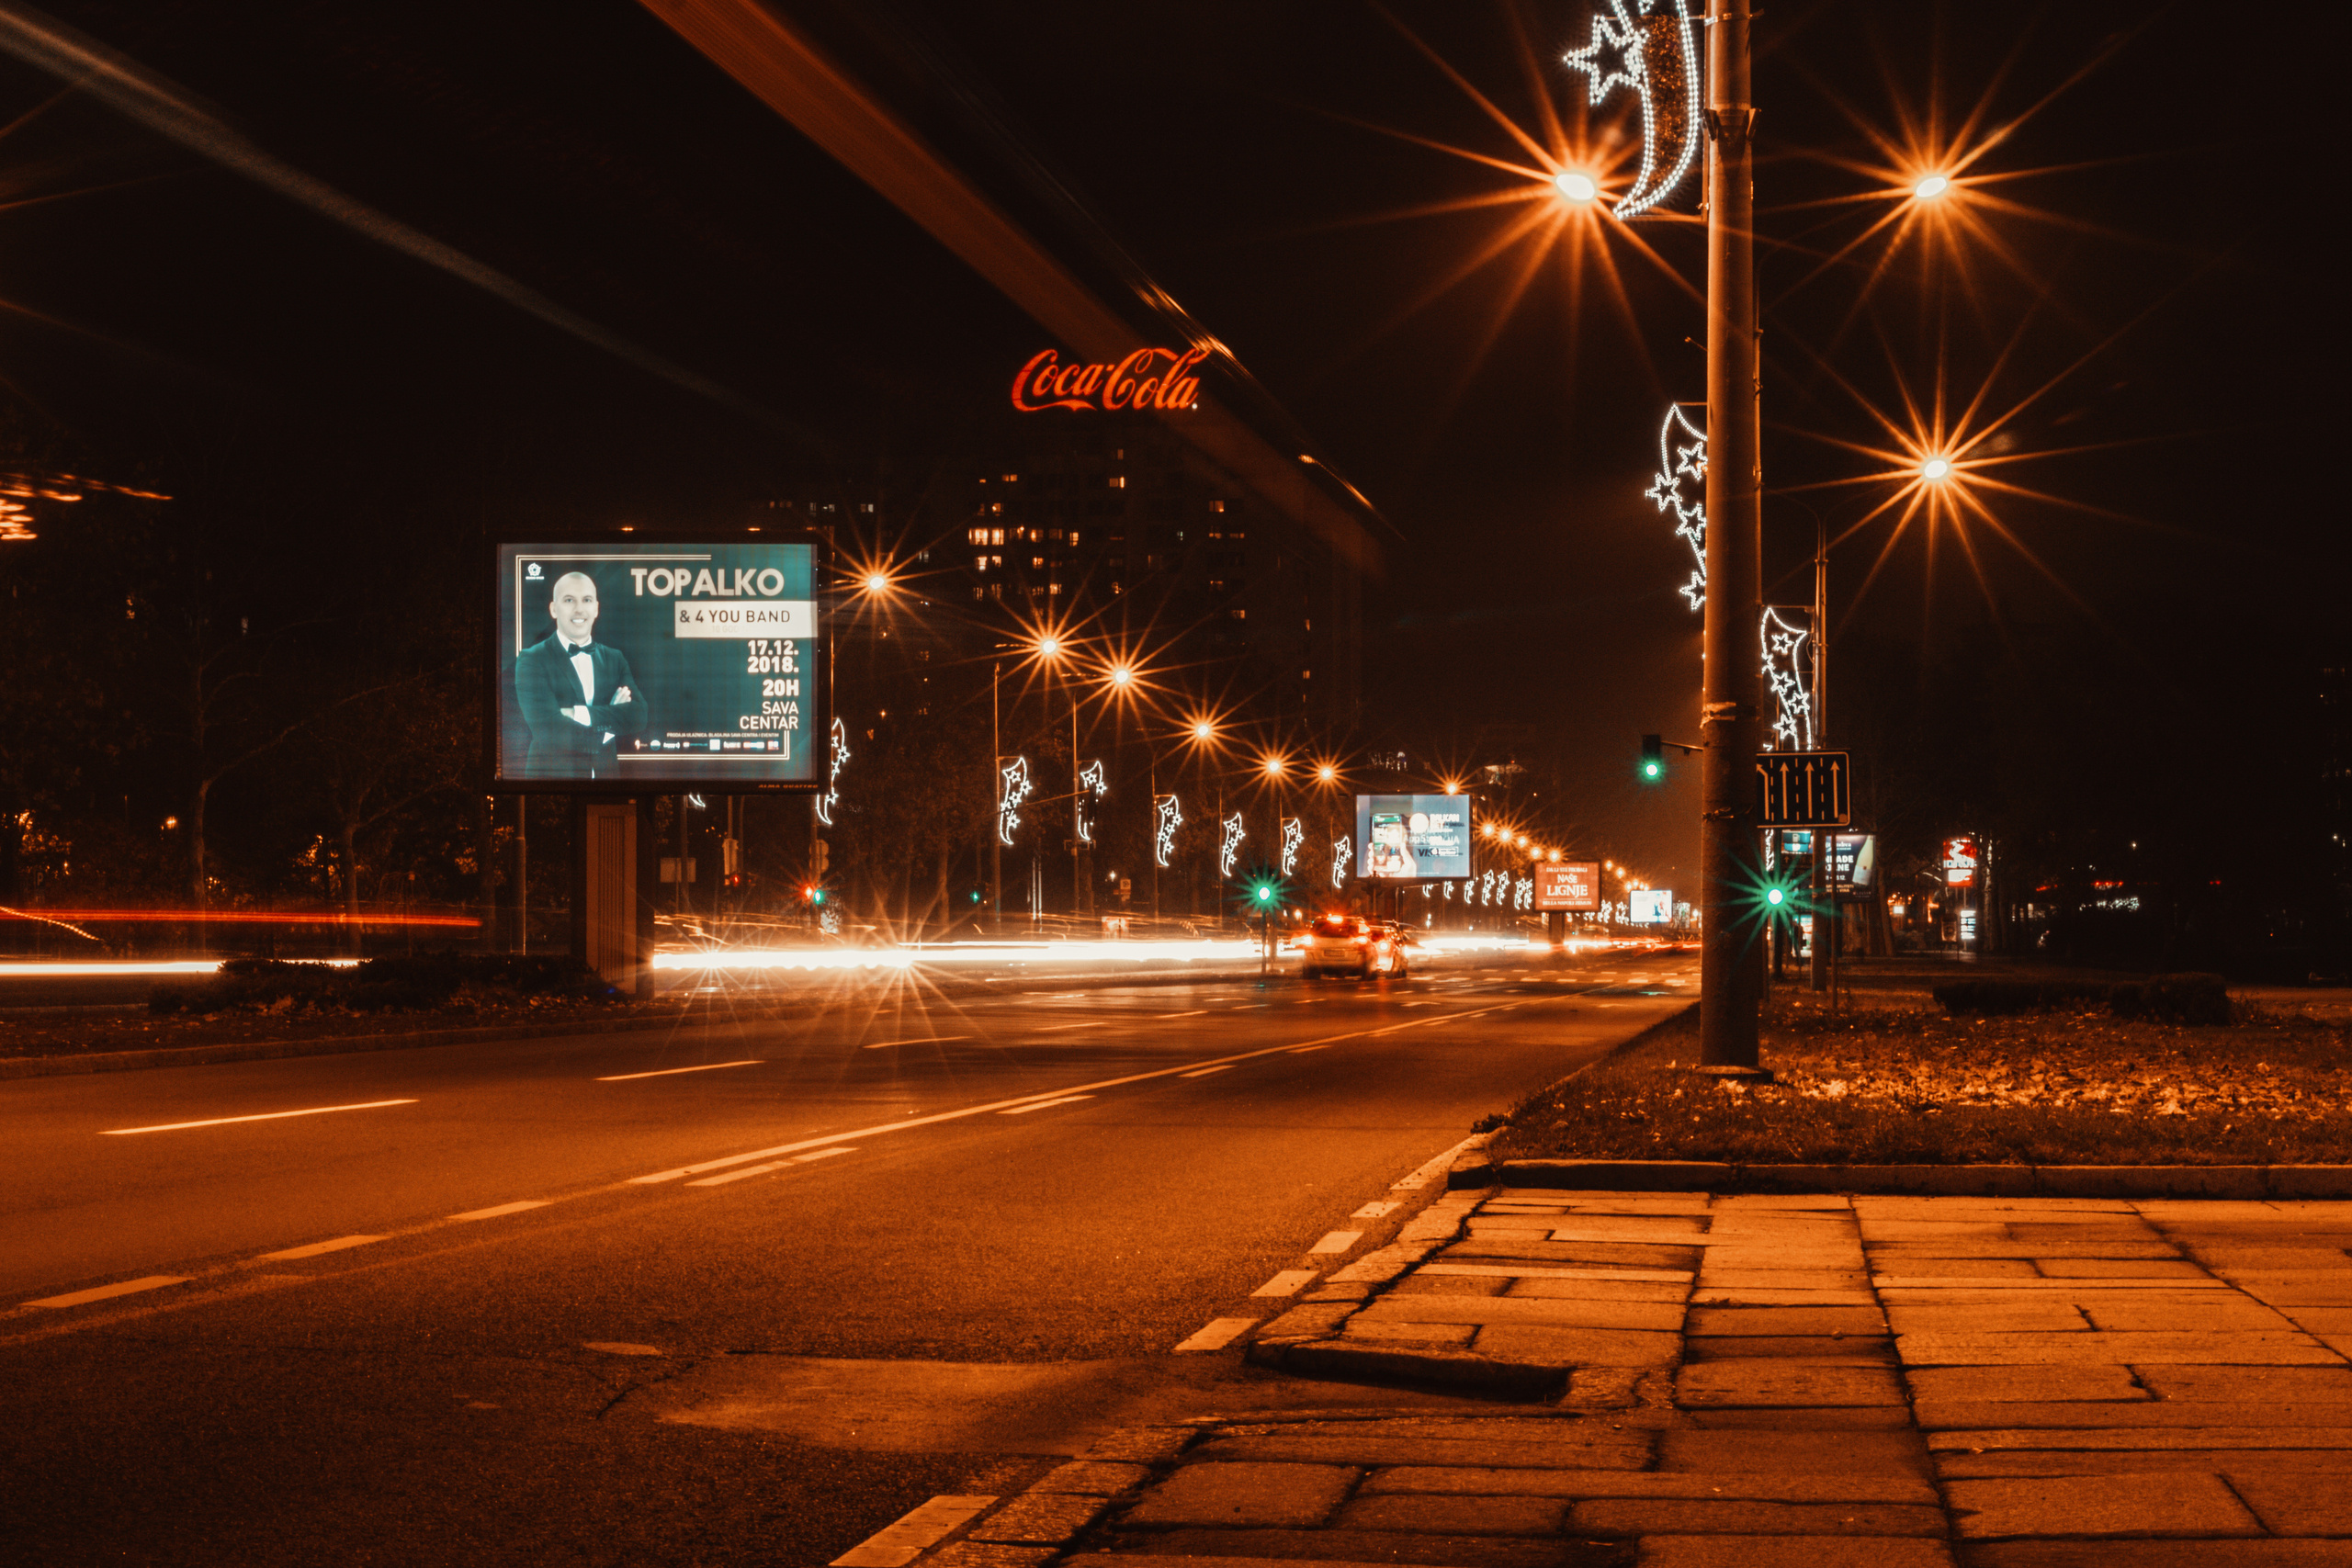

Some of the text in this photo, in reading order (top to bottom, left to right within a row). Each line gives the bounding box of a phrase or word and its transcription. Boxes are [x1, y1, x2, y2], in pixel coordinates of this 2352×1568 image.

[1012, 348, 1212, 412] Coca-Cola
[630, 568, 785, 597] TOPALKO
[680, 610, 790, 623] & 4 YOU BAND
[748, 640, 799, 656] 17.12.
[748, 656, 799, 673] 2018.
[763, 679, 799, 696] 20H
[763, 701, 799, 715] SAVA
[740, 716, 798, 729] CENTAR
[1557, 873, 1577, 884] NAŠE
[1546, 885, 1589, 898] LIGNJE
